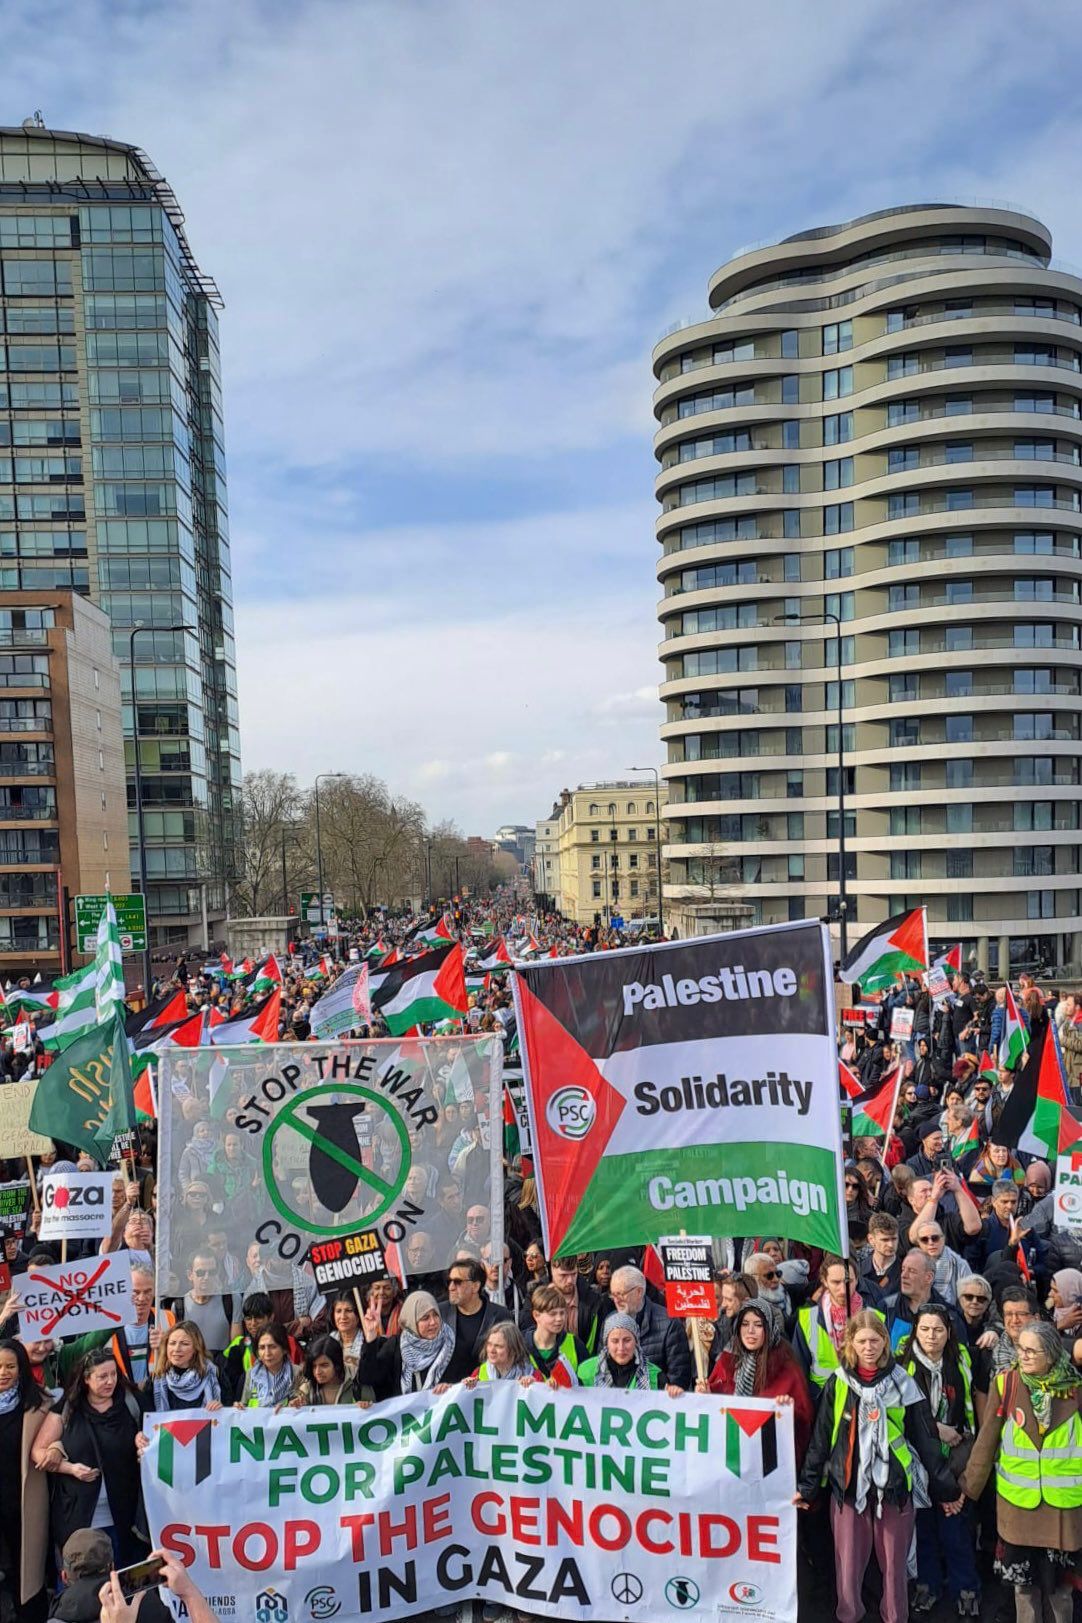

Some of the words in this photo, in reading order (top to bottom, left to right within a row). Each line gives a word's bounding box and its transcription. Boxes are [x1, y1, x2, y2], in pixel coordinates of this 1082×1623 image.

[623, 965, 798, 1016] Palestine
[235, 1064, 301, 1134] STOP
[311, 1055, 377, 1081] THE
[380, 1065, 439, 1131] WAR
[633, 1072, 813, 1117] Solidarity
[558, 1104, 590, 1123] PSC
[45, 1184, 104, 1209] Gza
[648, 1170, 828, 1216] Campaign
[61, 1213, 105, 1222] massacre
[311, 1241, 342, 1265] STOP
[344, 1232, 379, 1255] GAZA
[665, 1246, 707, 1262] FREEDOM
[60, 1271, 88, 1286] NO
[315, 1250, 385, 1285] GENOCIDE
[666, 1266, 711, 1281] PALESTINE
[24, 1280, 127, 1307] CEASEFIRE
[230, 1397, 499, 1463] NATIONAL
[516, 1399, 709, 1453] MARCH
[268, 1462, 376, 1507] FOR
[393, 1441, 671, 1498] PALESTINE
[160, 1519, 322, 1572] STOP
[340, 1493, 453, 1563] THE
[471, 1491, 781, 1564] GENOCIDE
[358, 1560, 417, 1613] IN
[436, 1545, 592, 1606] GAZA
[205, 1595, 236, 1607] IENDS
